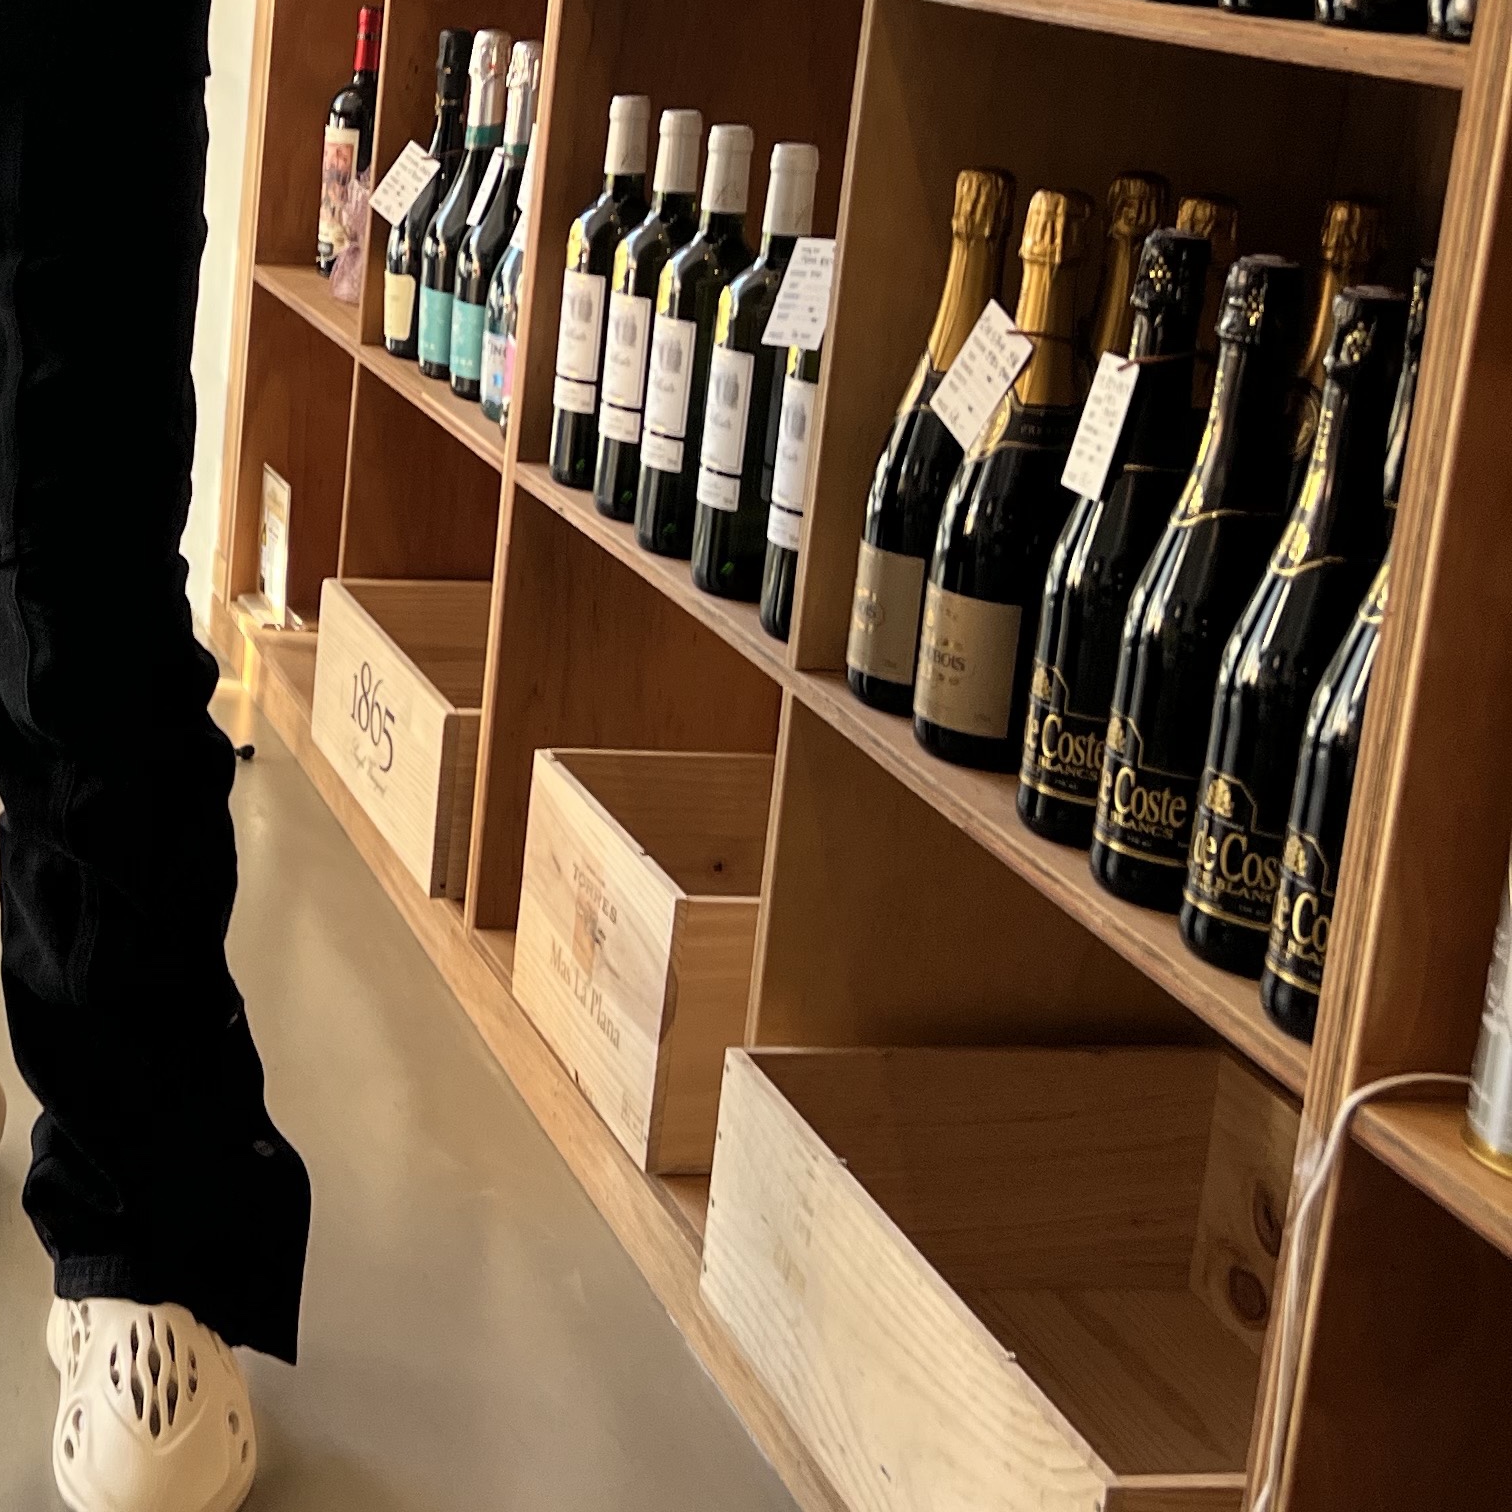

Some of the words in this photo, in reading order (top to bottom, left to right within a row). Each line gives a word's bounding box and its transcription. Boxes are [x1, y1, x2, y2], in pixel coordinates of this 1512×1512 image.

[351, 661, 395, 773] 1865
[1114, 766, 1188, 829] Coste
[1219, 833, 1279, 890] Cos
[571, 862, 619, 926] TORRES
[1292, 892, 1331, 954] Co
[550, 933, 572, 985] Mas
[589, 989, 621, 1052] Plana
